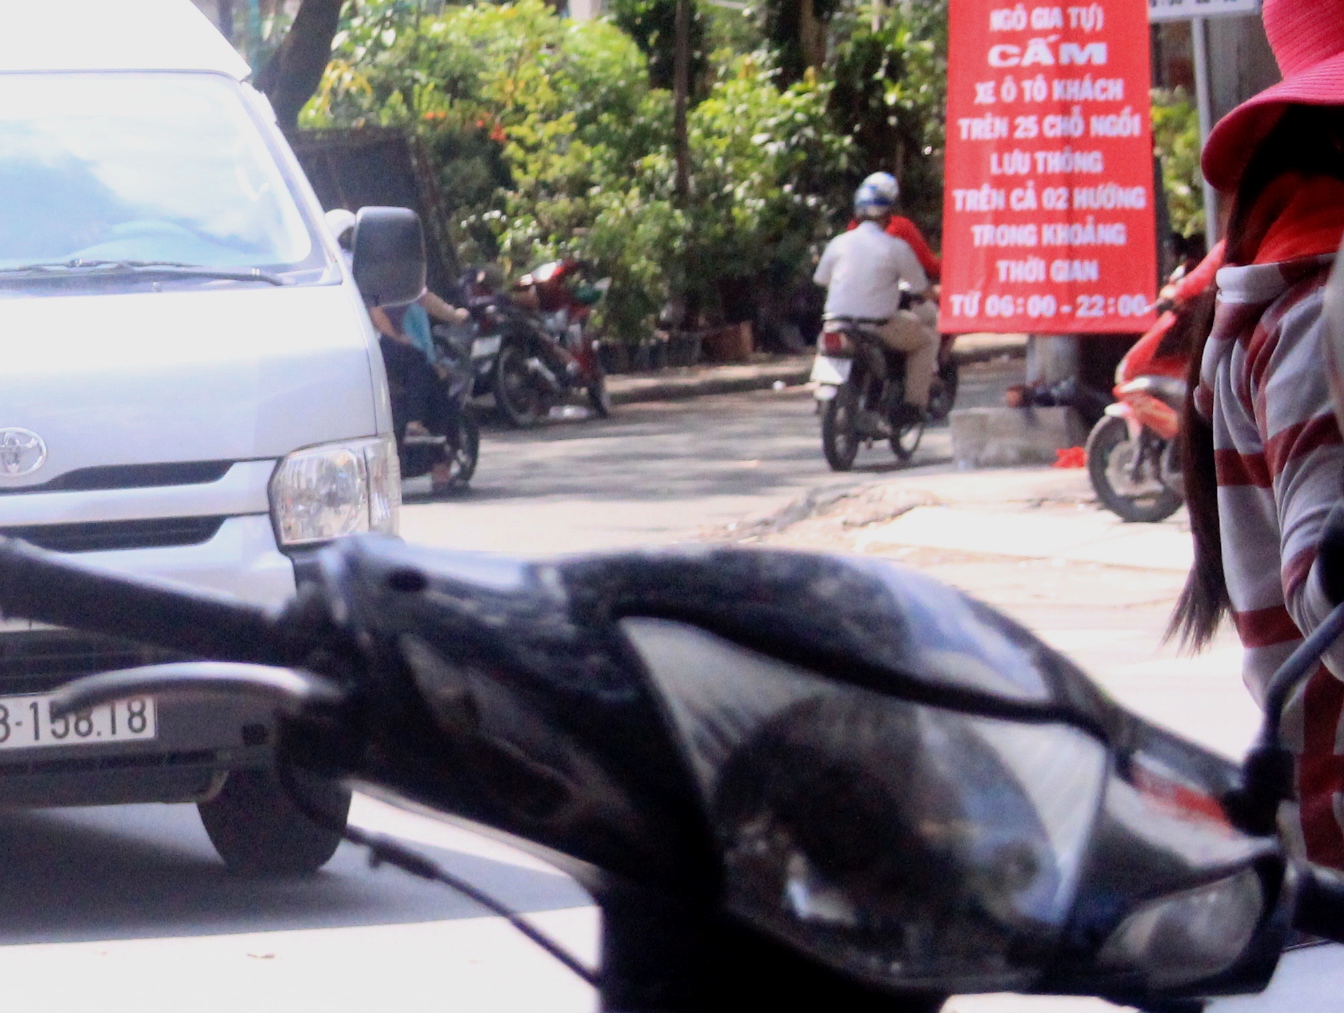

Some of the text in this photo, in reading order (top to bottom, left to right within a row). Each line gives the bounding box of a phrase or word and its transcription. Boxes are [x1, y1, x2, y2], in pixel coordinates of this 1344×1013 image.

[987, 34, 1108, 67] CẤM
[973, 80, 997, 105] XE
[1014, 115, 1039, 139] 25
[1041, 186, 1069, 210] 02
[971, 223, 1039, 247] TRONG
